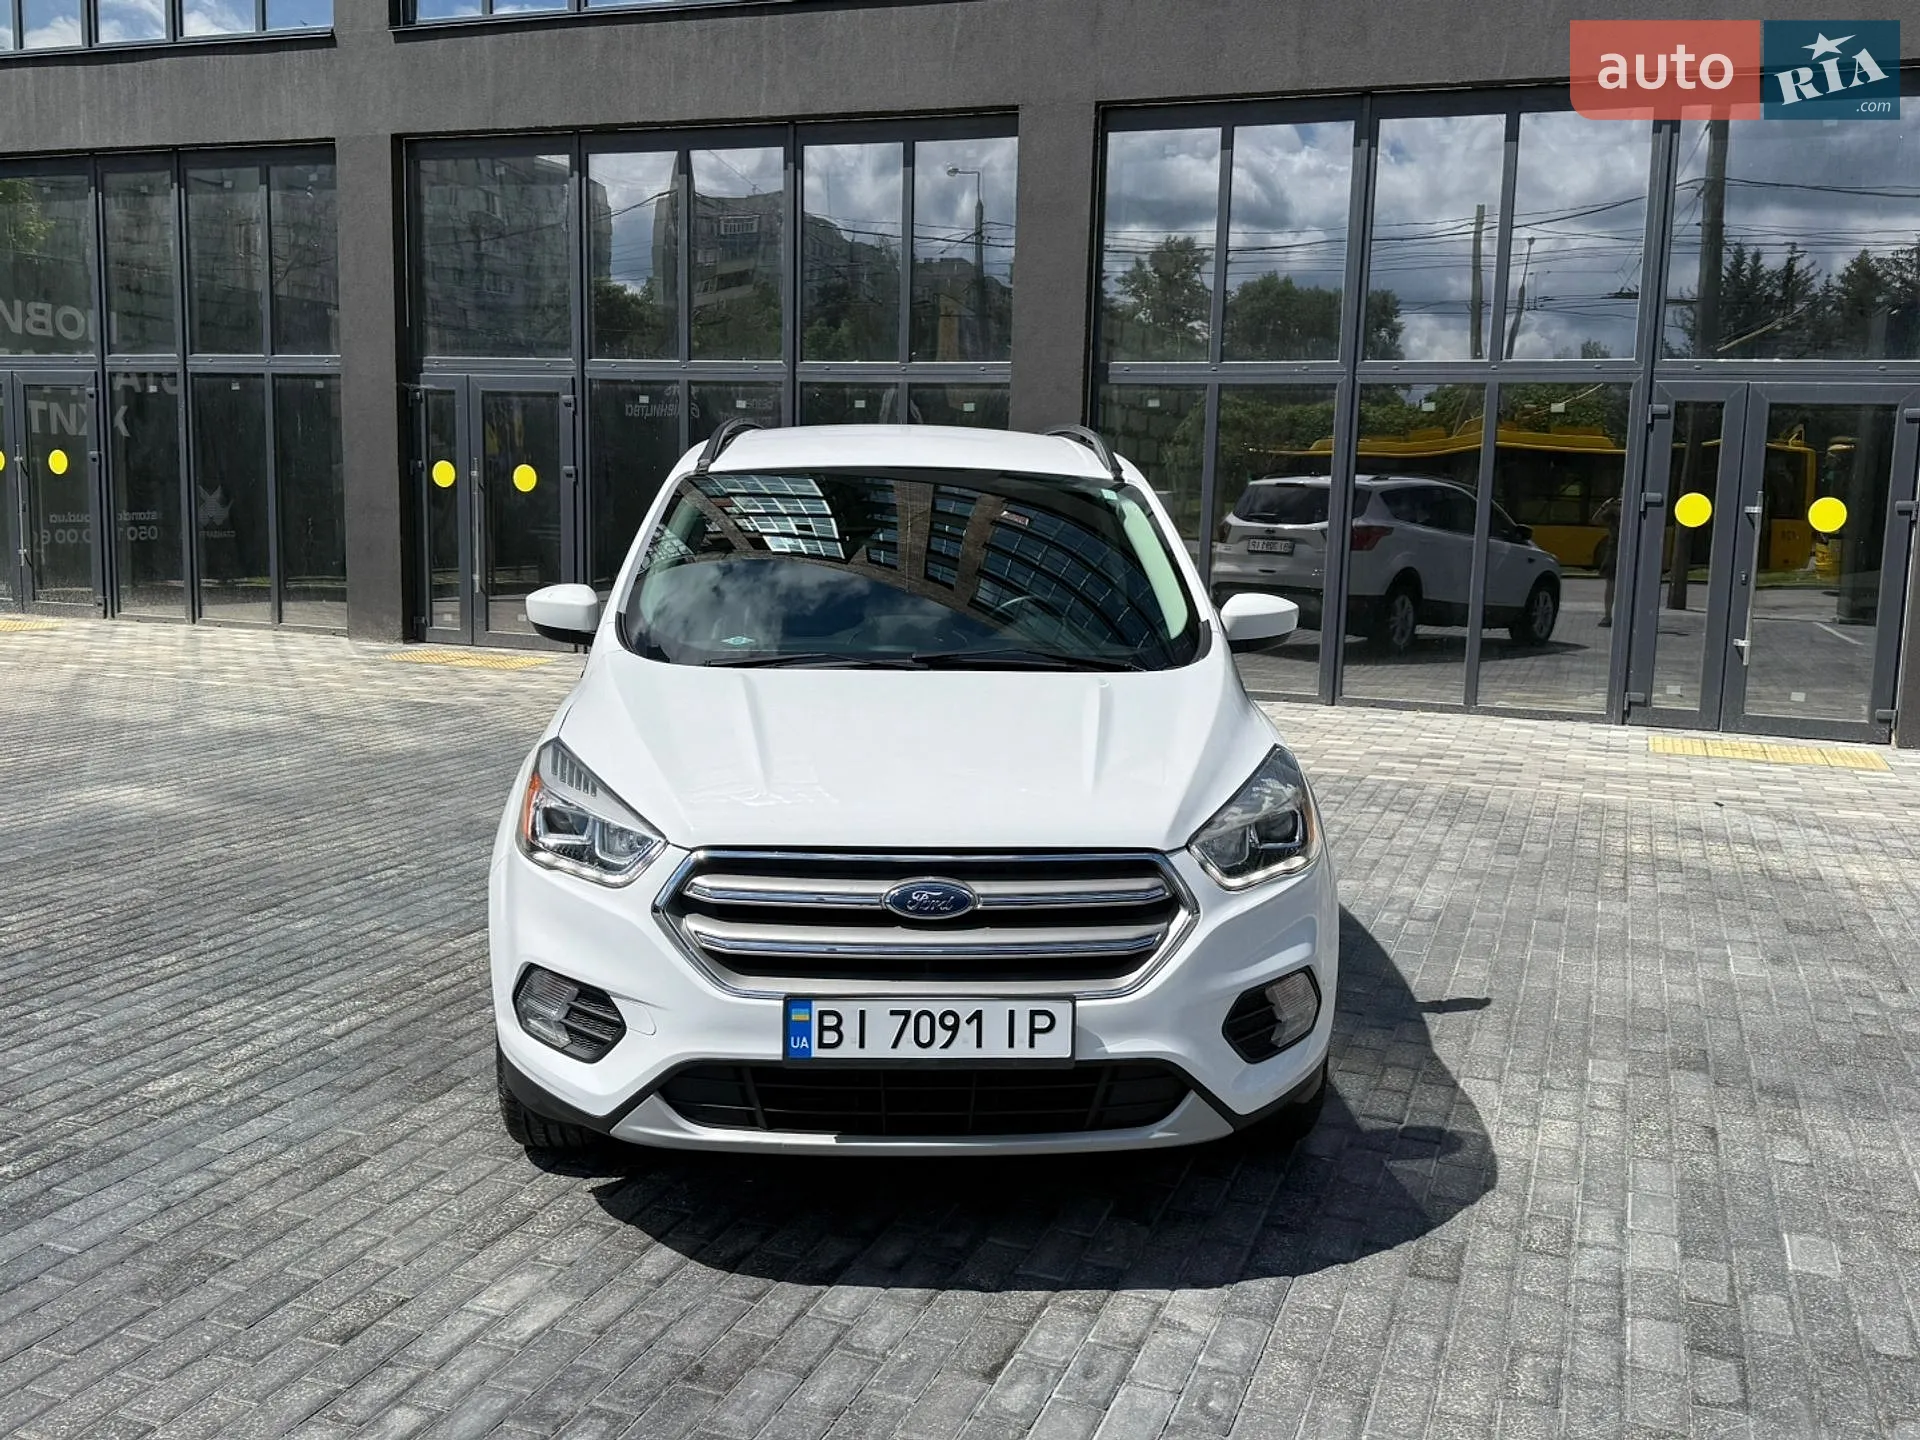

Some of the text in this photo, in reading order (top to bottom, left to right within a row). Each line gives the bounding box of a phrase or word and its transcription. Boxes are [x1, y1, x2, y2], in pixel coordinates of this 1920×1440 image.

[906, 890, 955, 911] Ford
[817, 1009, 1056, 1049] BI 7091 IP
[790, 1036, 809, 1048] UA
